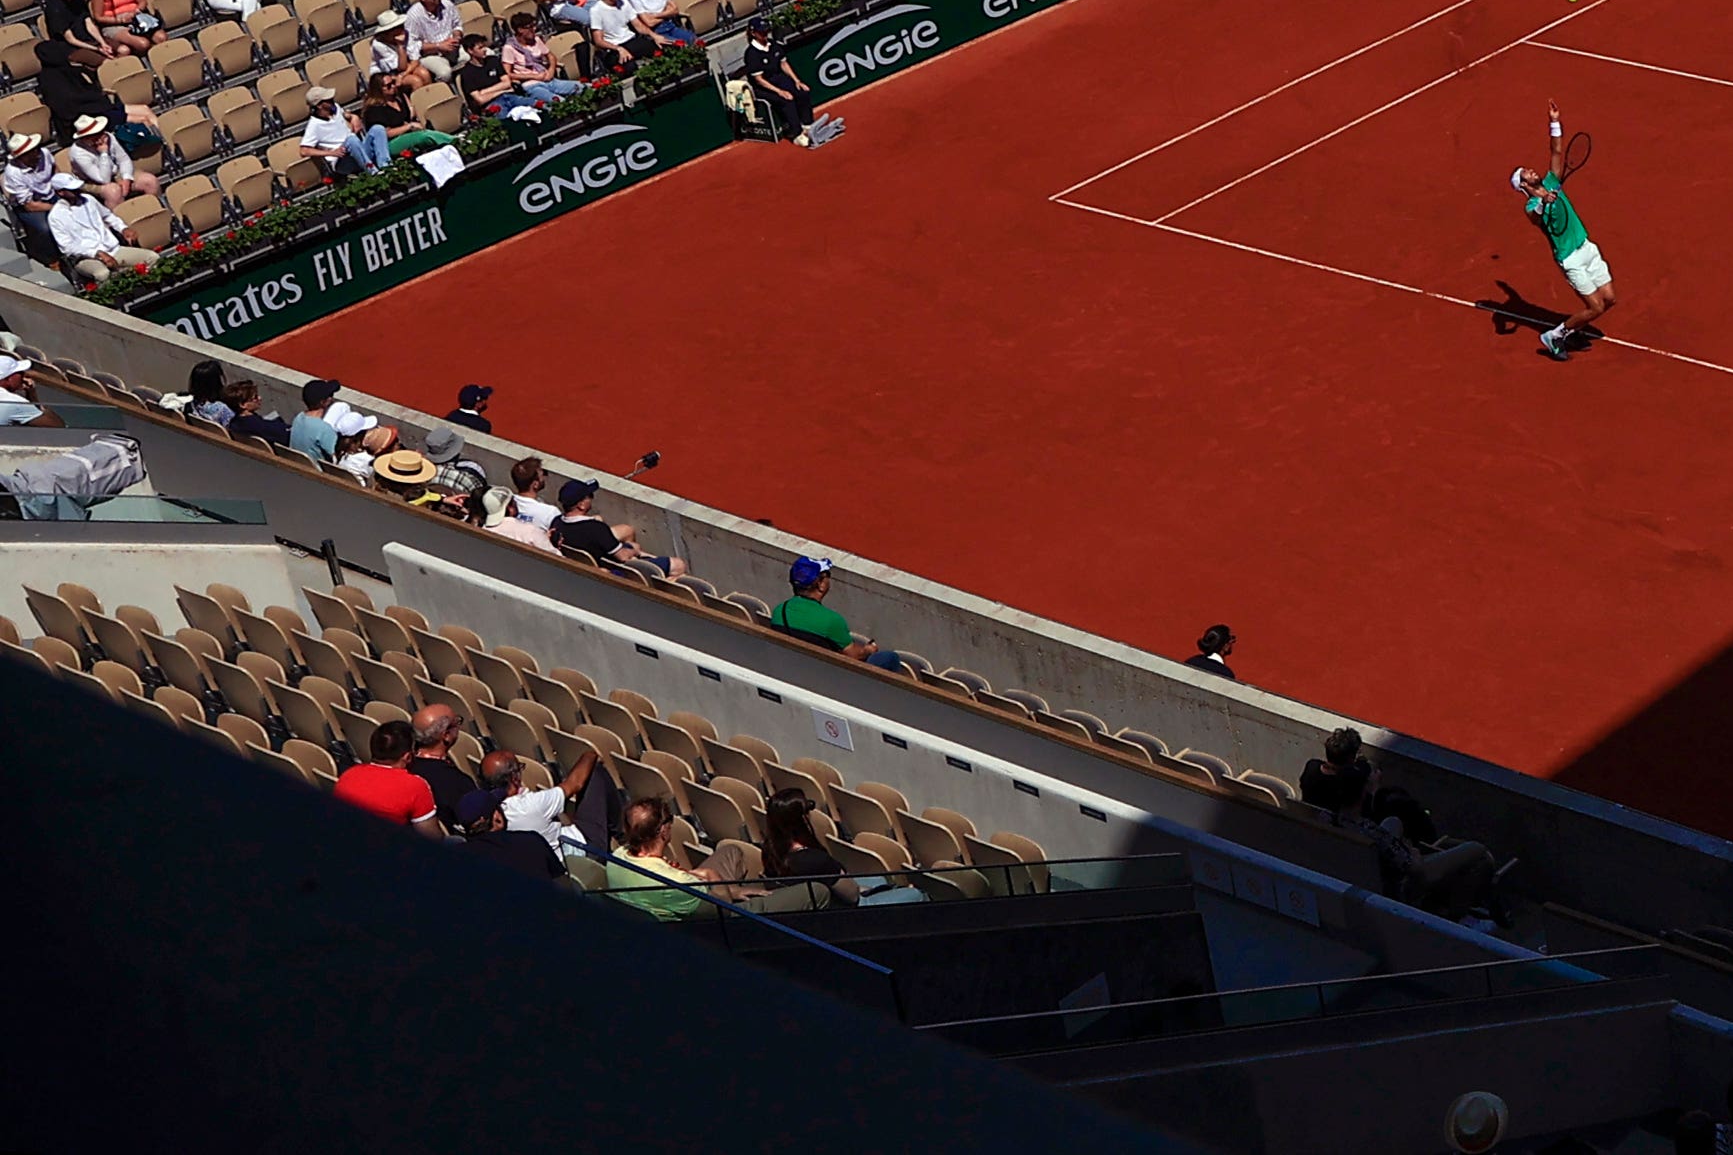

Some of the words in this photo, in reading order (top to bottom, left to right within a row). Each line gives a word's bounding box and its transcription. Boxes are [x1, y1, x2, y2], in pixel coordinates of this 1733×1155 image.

[163, 273, 302, 341] mirates
[313, 242, 353, 292] FLY
[361, 206, 448, 273] BETTER
